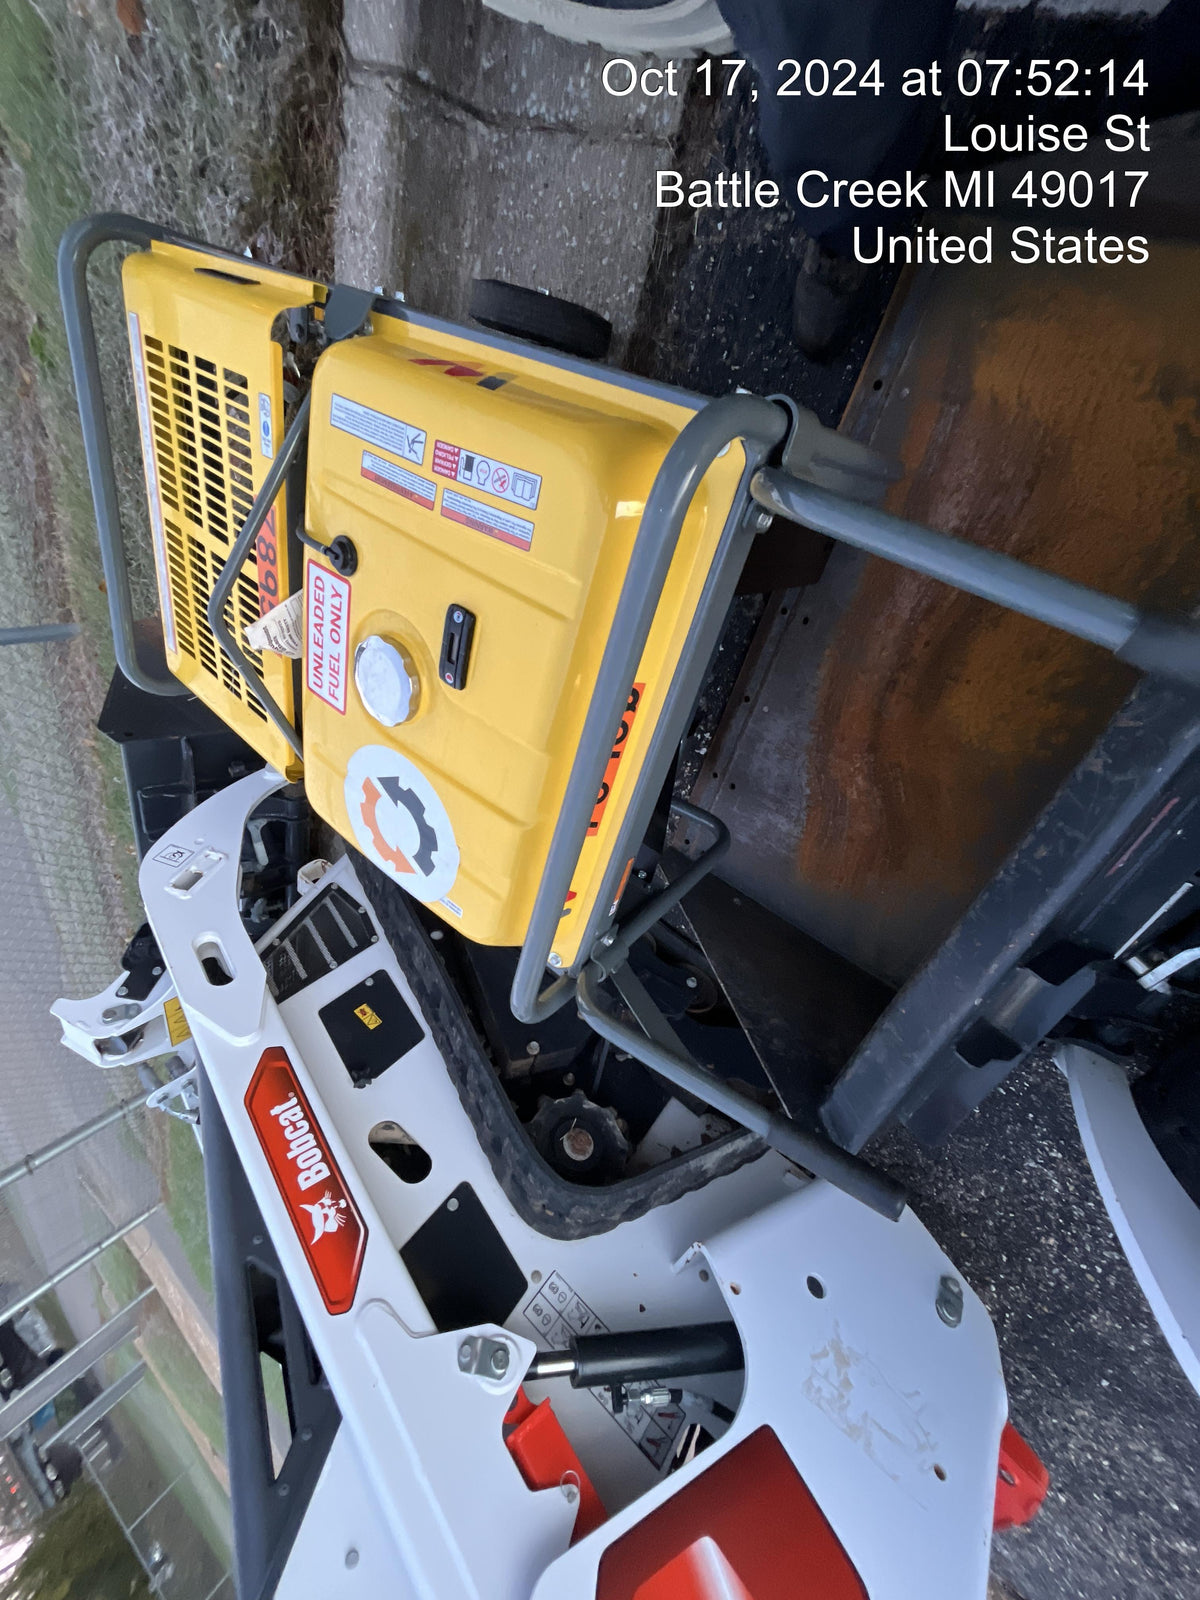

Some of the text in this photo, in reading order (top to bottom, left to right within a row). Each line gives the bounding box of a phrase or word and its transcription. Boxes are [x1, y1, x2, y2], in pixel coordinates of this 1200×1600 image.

[313, 575, 325, 689] UNLEADED
[328, 584, 343, 701] FUEL ONLY
[269, 1096, 331, 1192] Bobcat
